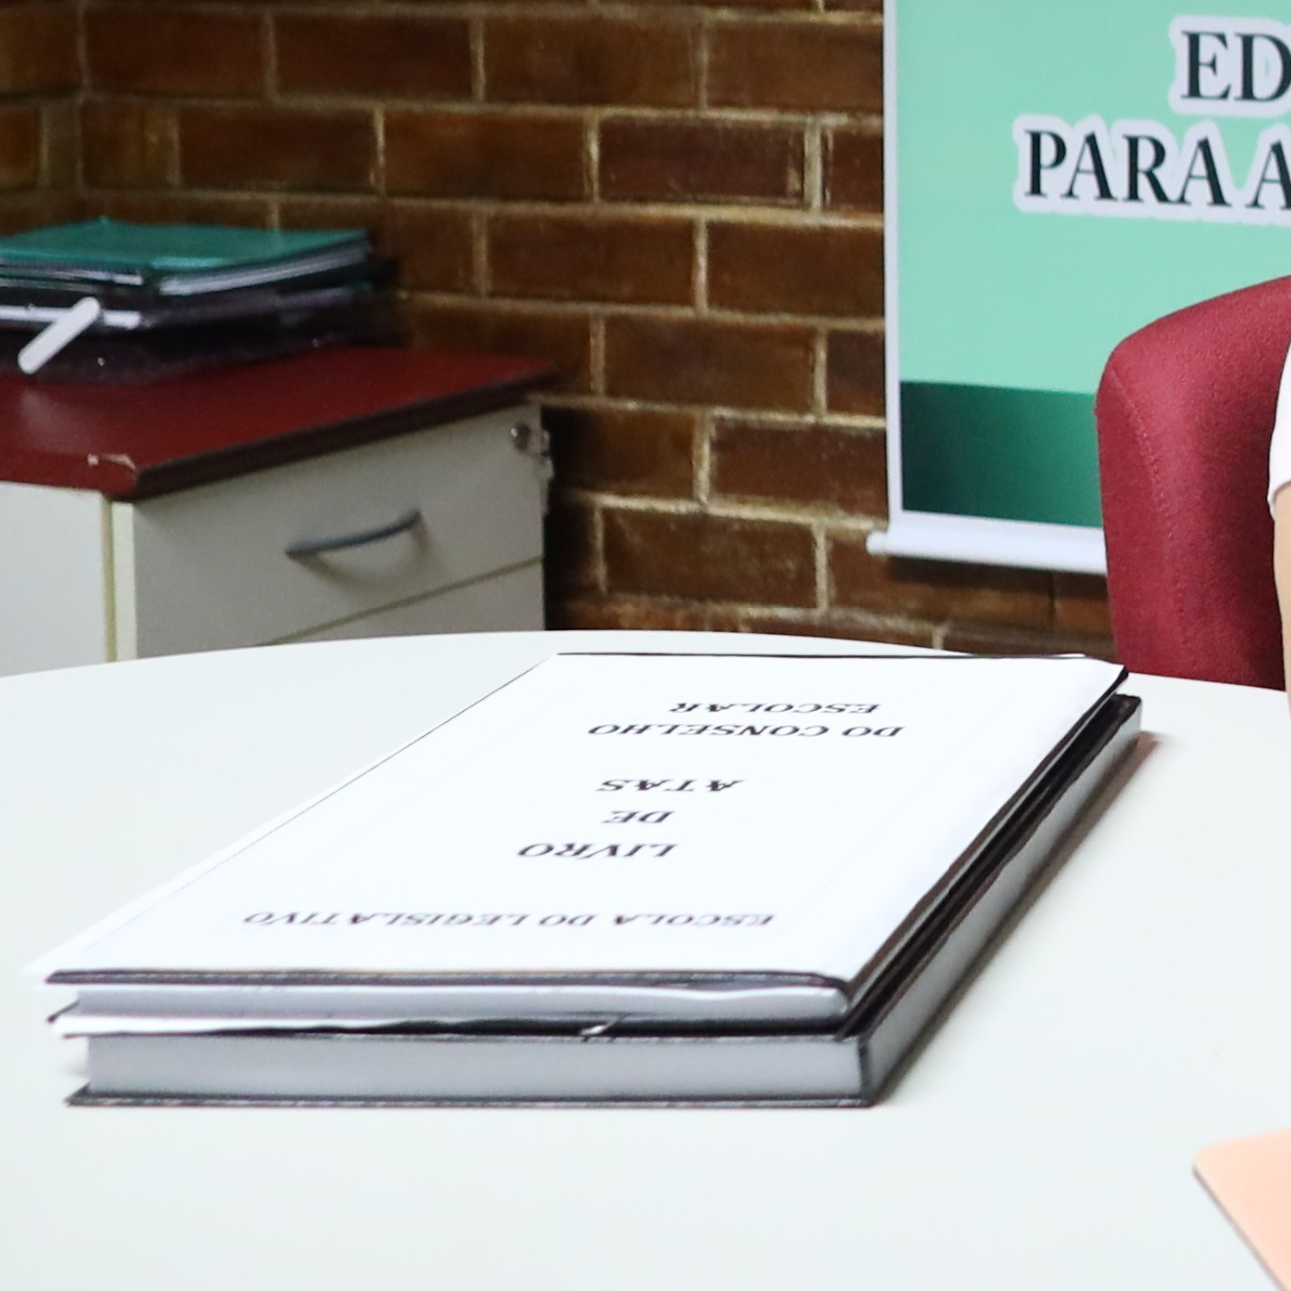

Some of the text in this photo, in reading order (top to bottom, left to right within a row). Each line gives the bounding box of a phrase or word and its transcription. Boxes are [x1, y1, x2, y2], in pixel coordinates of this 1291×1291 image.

[1024, 130, 1232, 208] PARA
[667, 701, 881, 714] ESCOLAR
[587, 723, 905, 738] DO CONSELHO
[595, 778, 744, 793] ATAS
[601, 810, 675, 825] DE
[516, 841, 678, 860] LIVRO
[243, 911, 776, 927] ESCOLA DO LEGISLATIVO
